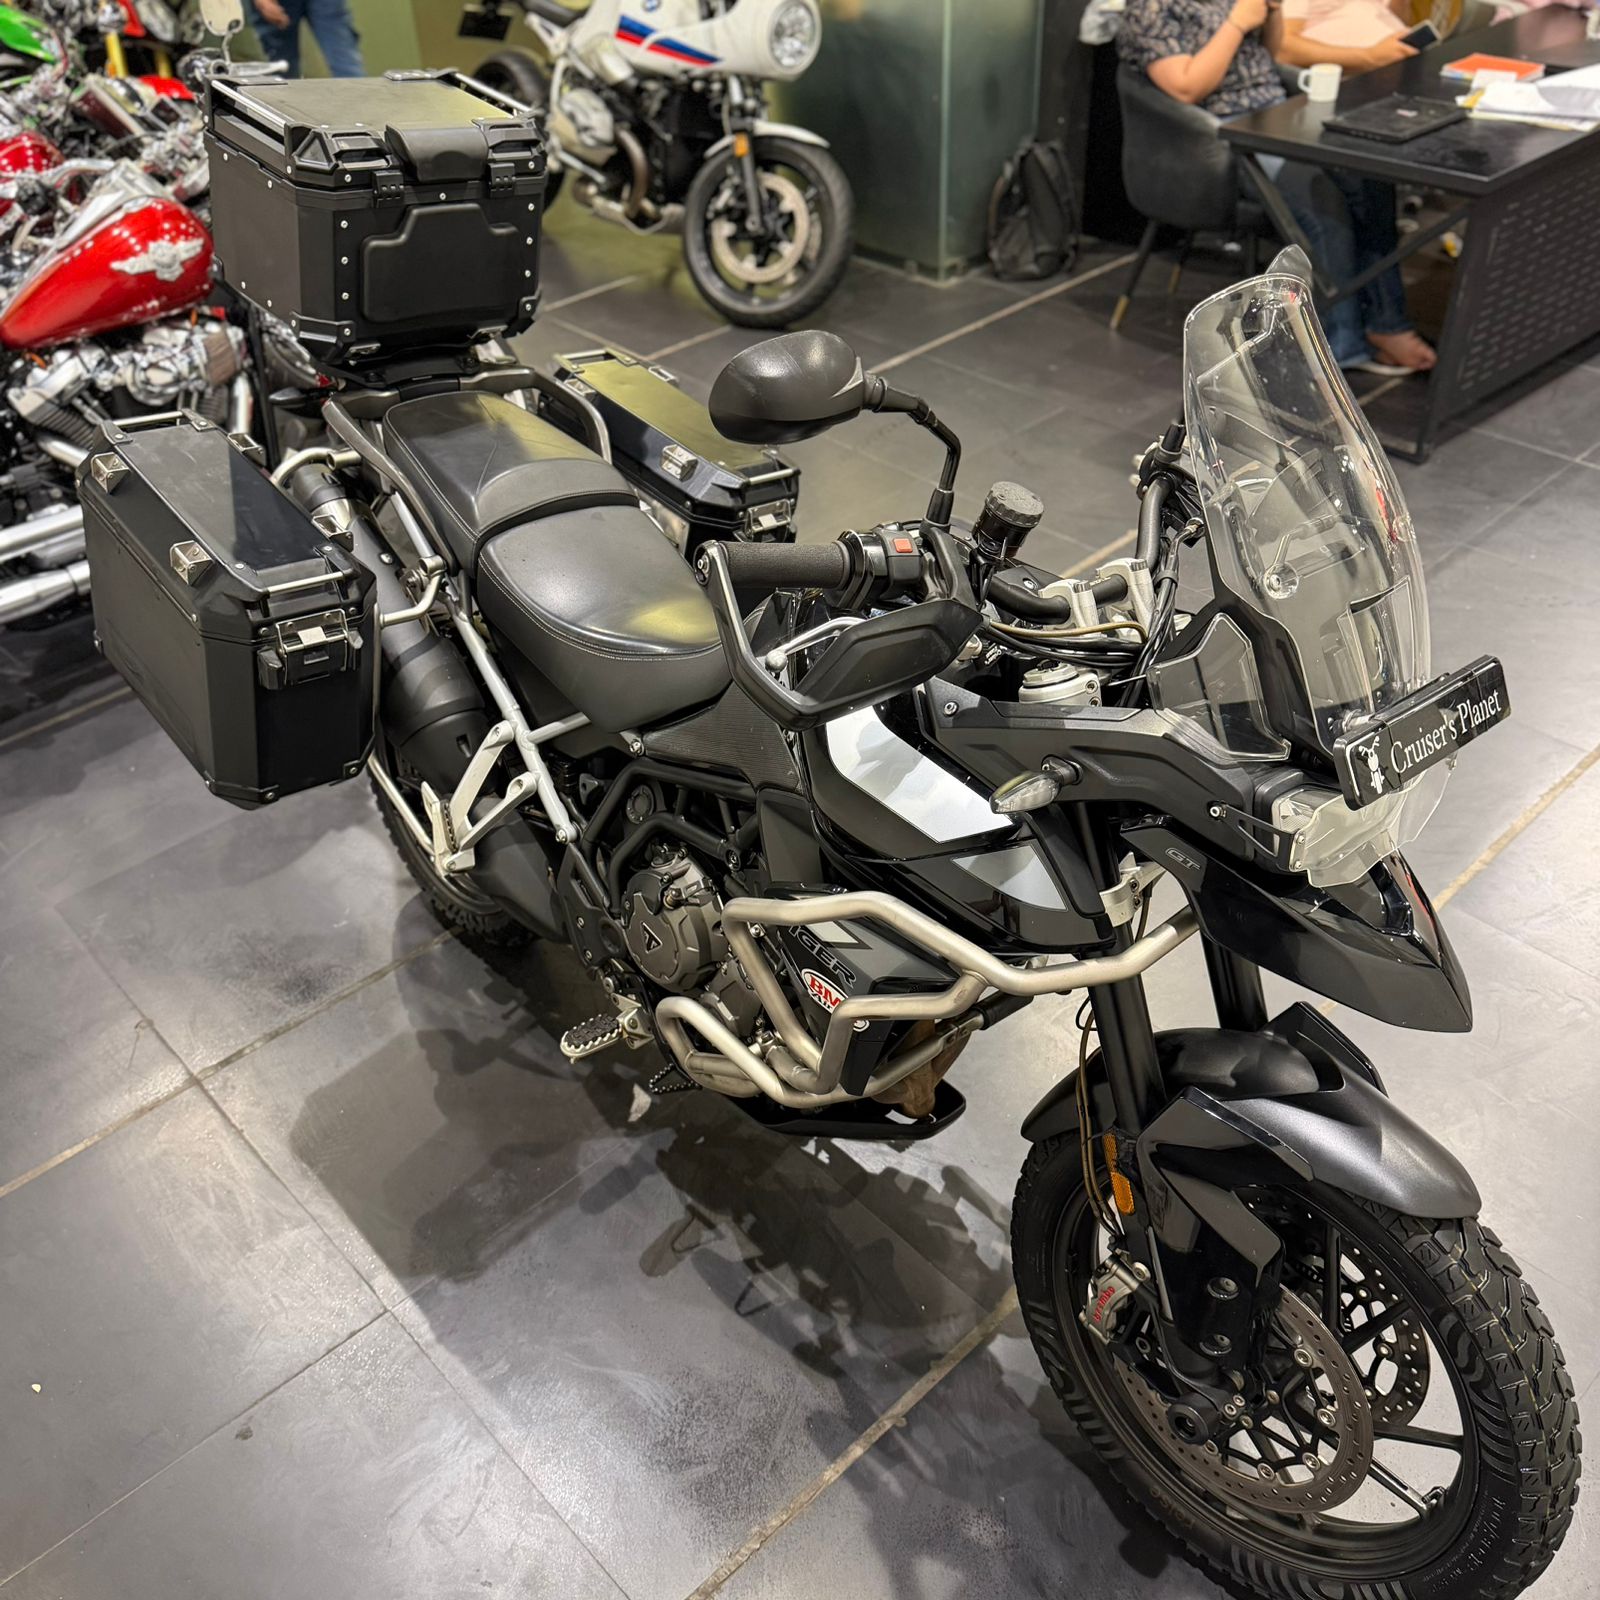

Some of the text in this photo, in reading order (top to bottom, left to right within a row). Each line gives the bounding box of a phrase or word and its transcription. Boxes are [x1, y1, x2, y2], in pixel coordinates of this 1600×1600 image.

[1390, 689, 1502, 774] Cruiser's Planet
[1165, 847, 1200, 870] GT
[788, 924, 857, 989] IGER
[808, 973, 841, 1007] BM
